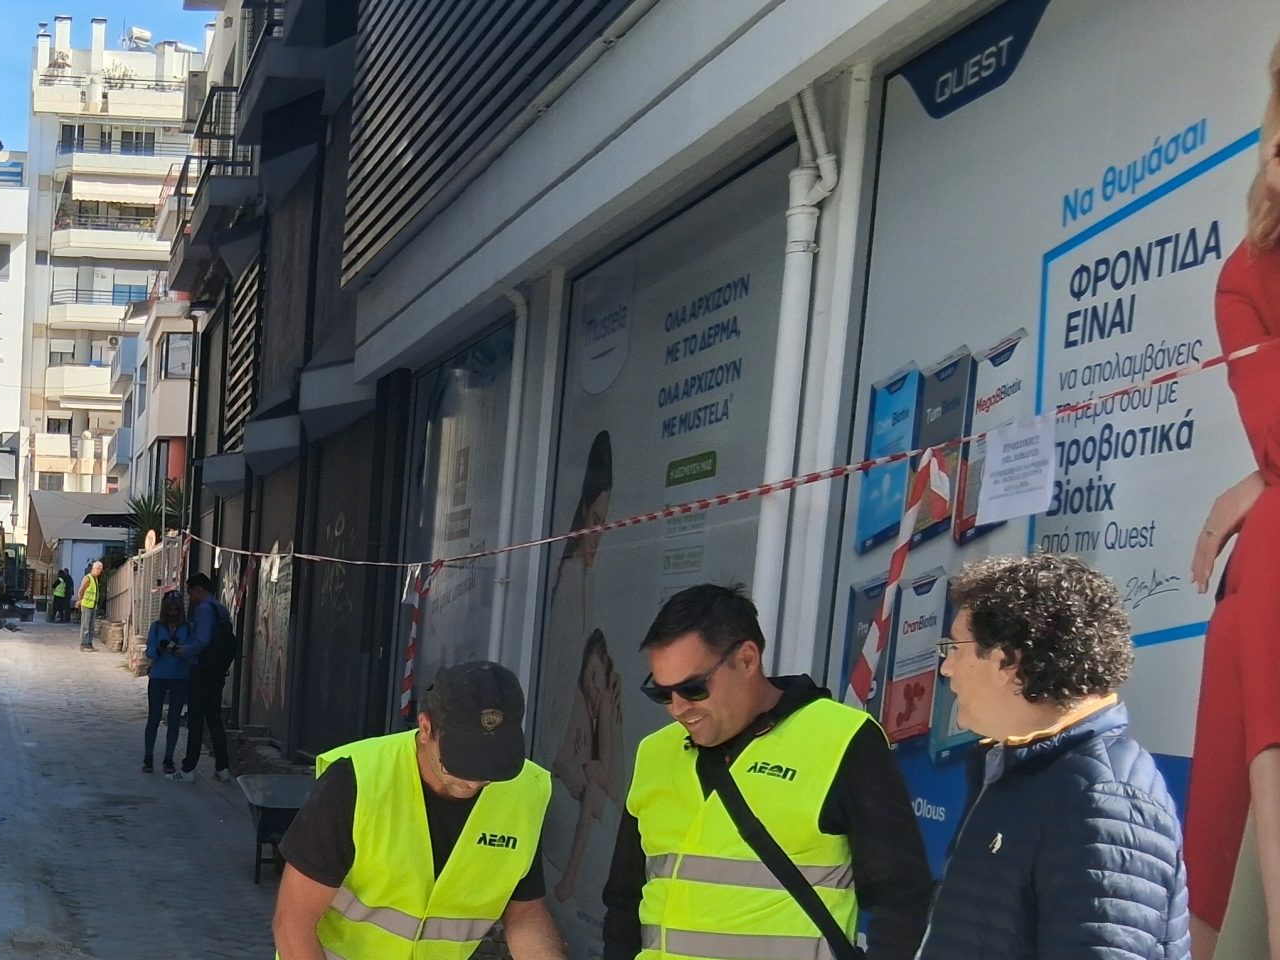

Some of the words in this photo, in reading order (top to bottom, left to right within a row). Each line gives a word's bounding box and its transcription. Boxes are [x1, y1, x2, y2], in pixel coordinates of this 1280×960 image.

[935, 35, 1014, 103] QUEST
[1062, 187, 1094, 228] Να
[1102, 118, 1207, 201] θυμάσαι
[1070, 220, 1222, 302] ΦΡΟΝΤΙΔΑ
[1064, 294, 1136, 349] ΕΙΝΑΙ
[1060, 368, 1078, 391] να
[1082, 339, 1202, 383] απολαμβάνεις
[1157, 381, 1179, 413] με
[1055, 408, 1194, 476] προβιοτικά
[1046, 475, 1116, 517] Biotix
[1041, 526, 1070, 553] από
[1074, 530, 1100, 552] την
[1104, 520, 1156, 550] Quest
